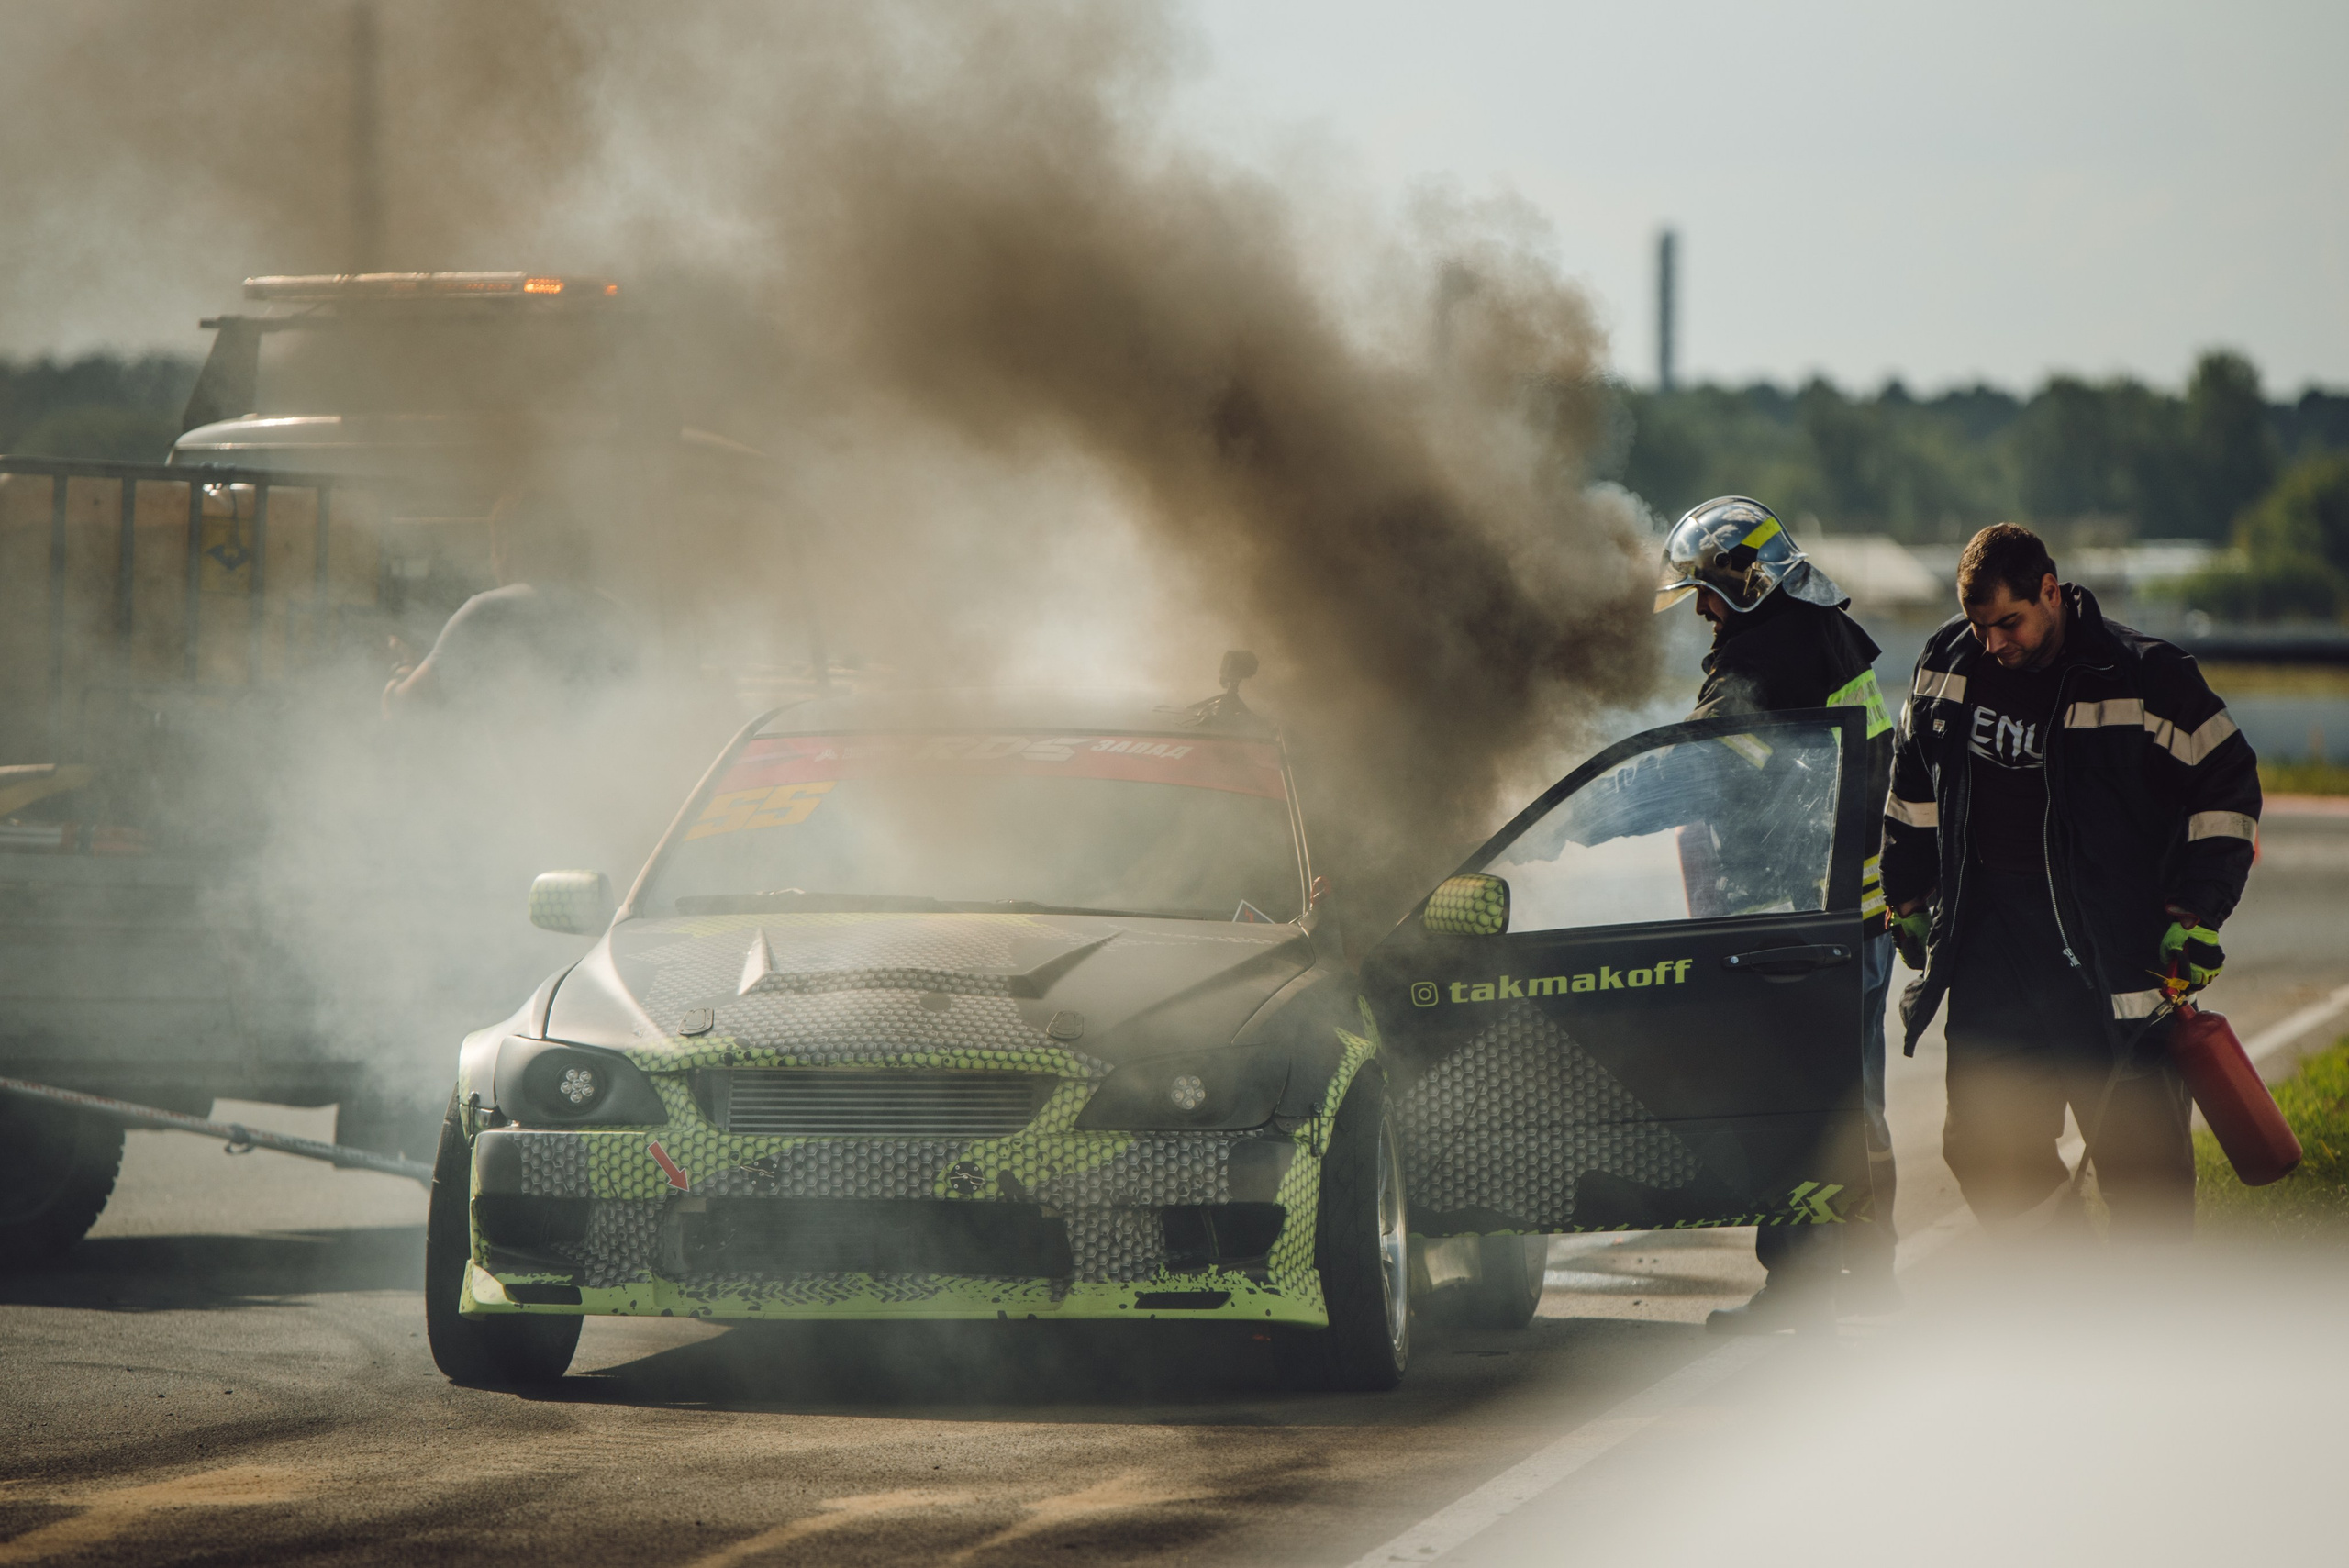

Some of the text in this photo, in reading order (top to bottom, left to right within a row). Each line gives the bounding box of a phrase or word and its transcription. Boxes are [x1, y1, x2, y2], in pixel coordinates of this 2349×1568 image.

[1090, 739, 1194, 761] ЗАПАД
[683, 780, 839, 842] 55
[1449, 959, 1693, 1003] takmakoff
